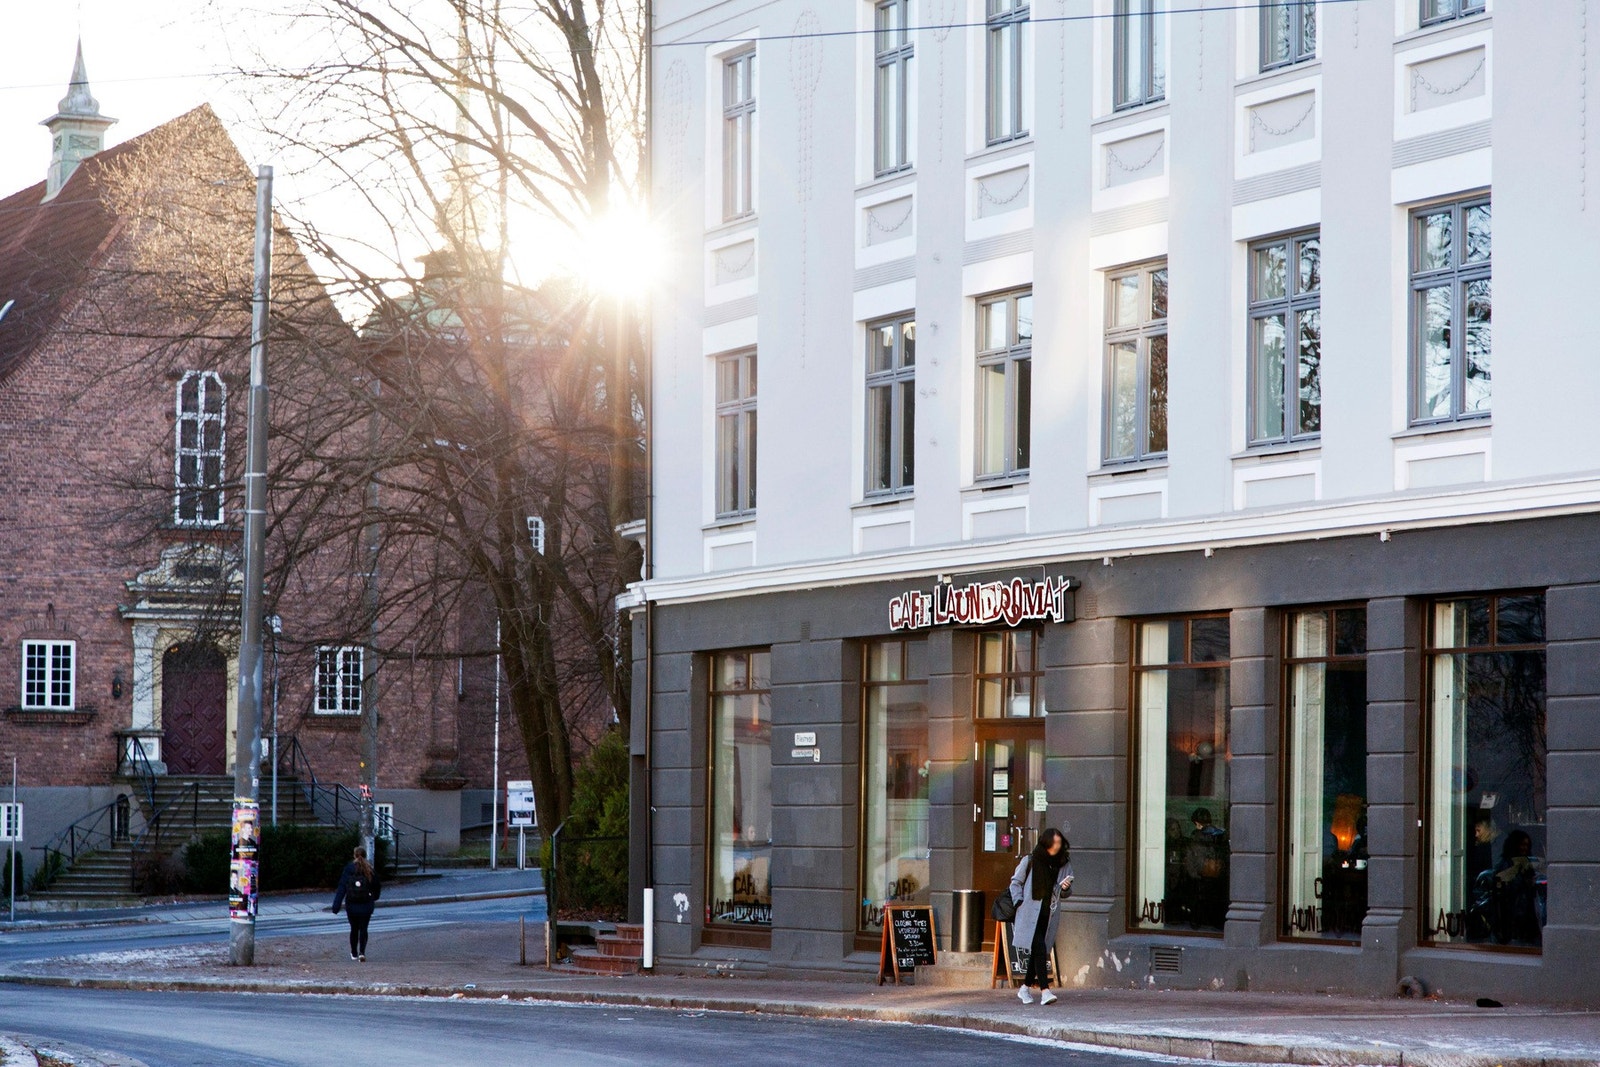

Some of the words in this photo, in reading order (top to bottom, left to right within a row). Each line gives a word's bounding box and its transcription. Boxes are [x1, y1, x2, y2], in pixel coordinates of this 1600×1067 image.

[889, 590, 932, 631] CAFE
[934, 575, 1070, 627] LAUNDROMAT
[902, 910, 916, 919] NEW
